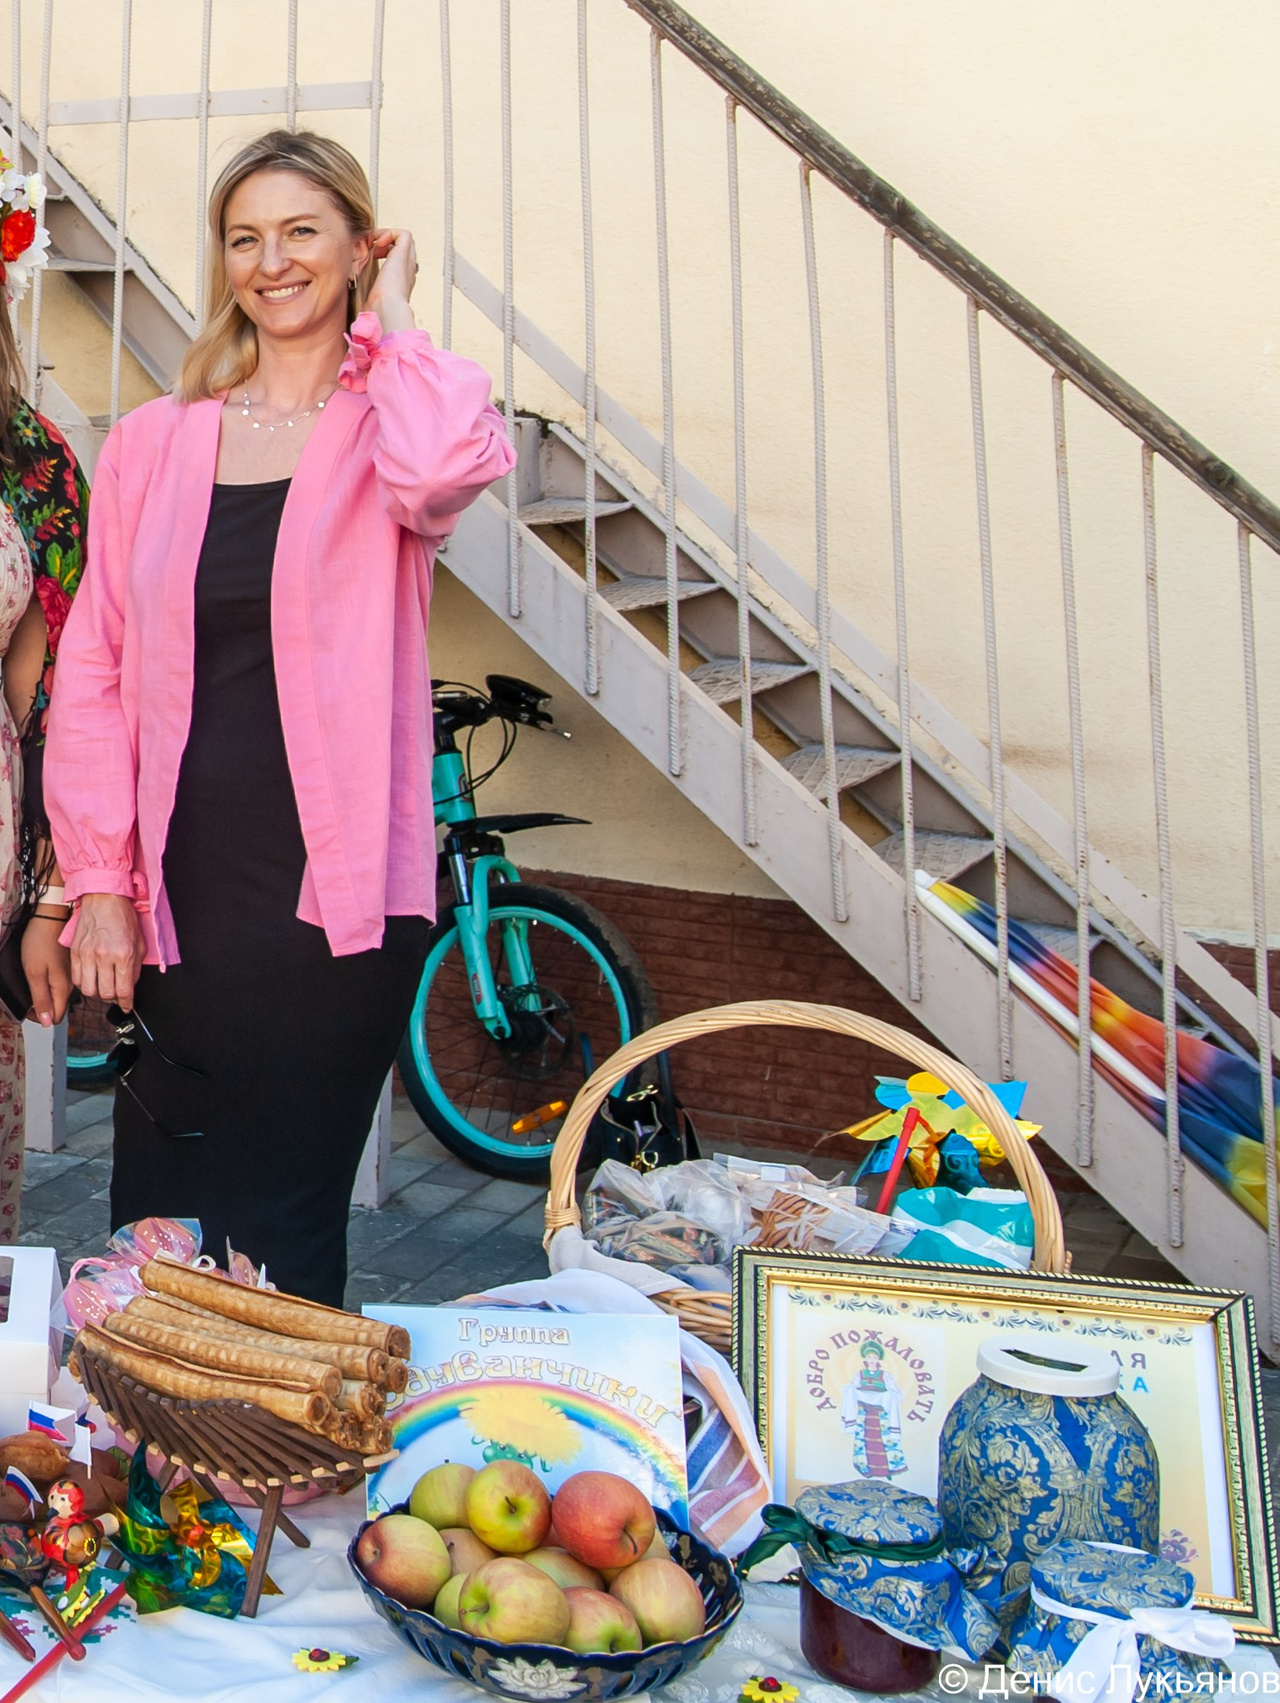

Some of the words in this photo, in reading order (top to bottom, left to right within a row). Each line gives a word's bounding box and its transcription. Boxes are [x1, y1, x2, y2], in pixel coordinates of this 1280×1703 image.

[459, 1317, 570, 1347] Группа
[806, 1348, 837, 1412] ДОБРО
[829, 1329, 936, 1423] ПОЖАЛОВАТЬ
